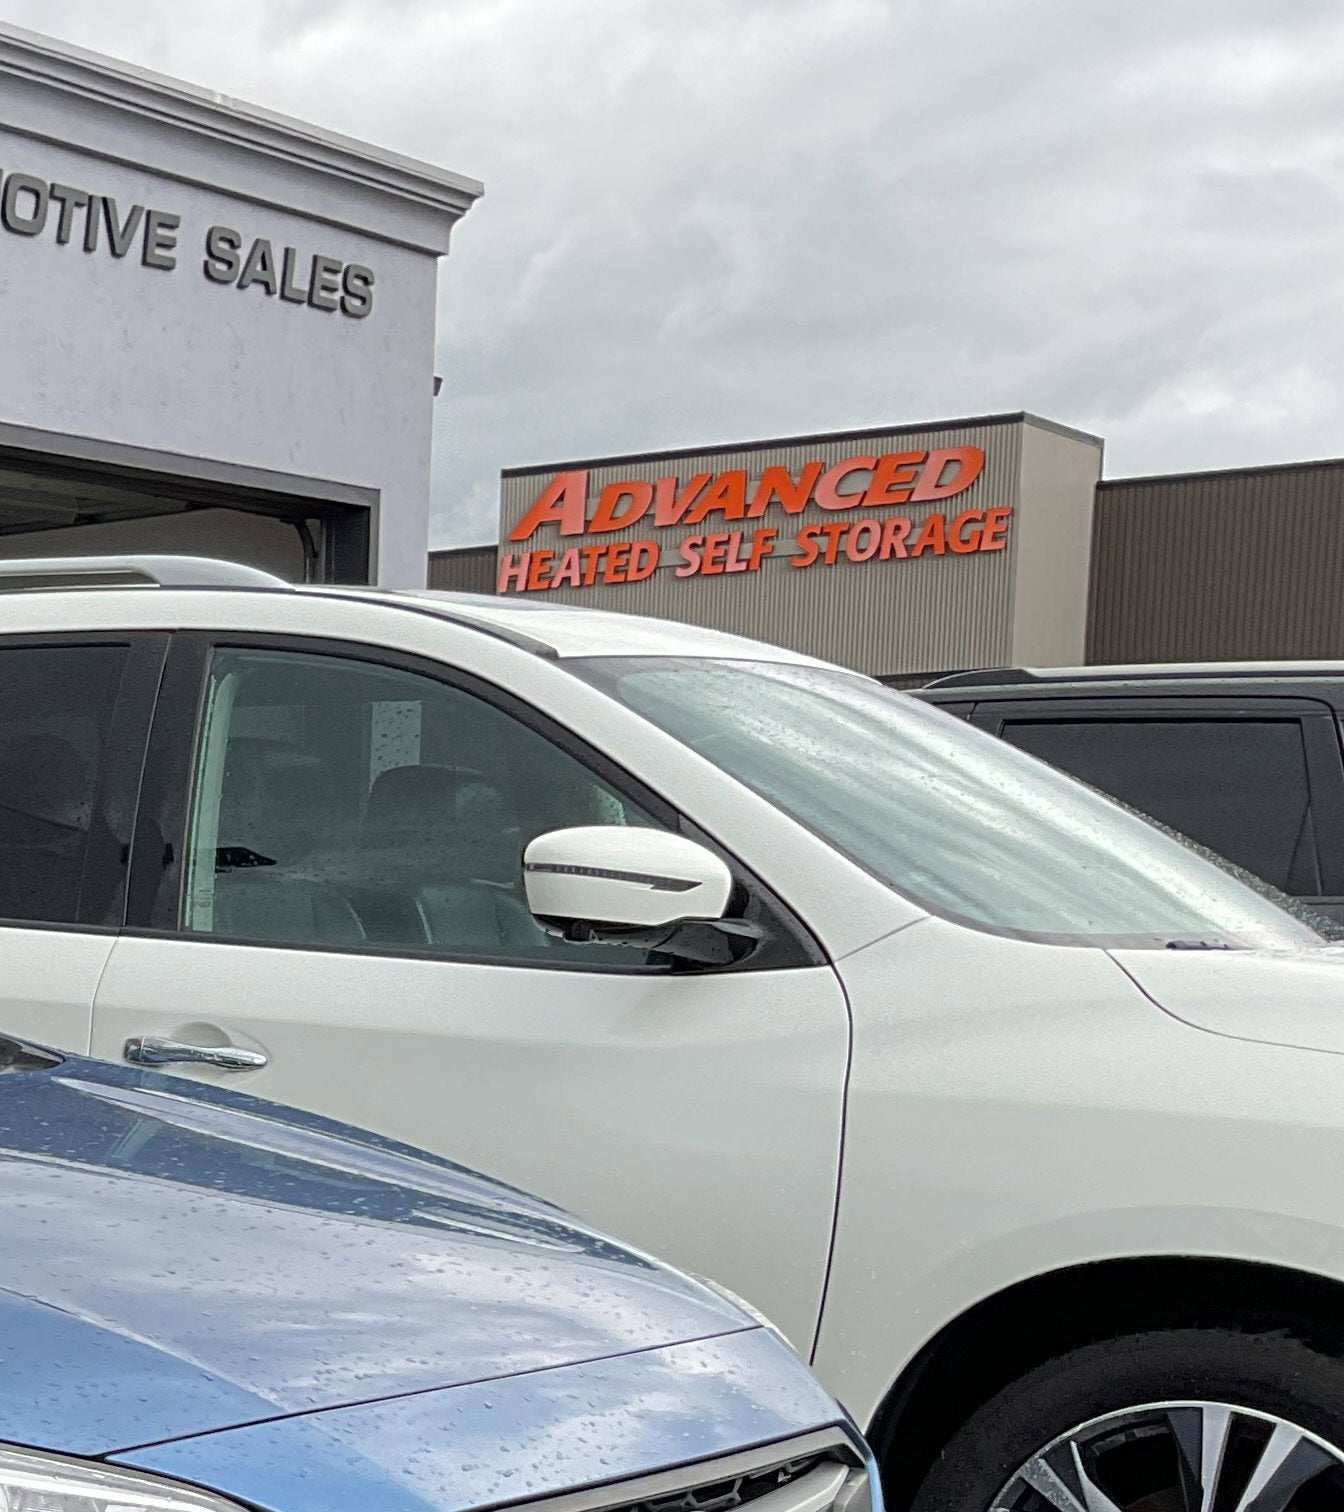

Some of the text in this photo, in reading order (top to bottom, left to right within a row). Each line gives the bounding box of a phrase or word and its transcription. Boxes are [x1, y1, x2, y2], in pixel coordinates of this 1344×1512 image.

[203, 226, 375, 318] SALES
[508, 446, 985, 542] ADVANCED
[498, 507, 1012, 593] HEATED SELF STORAGE
